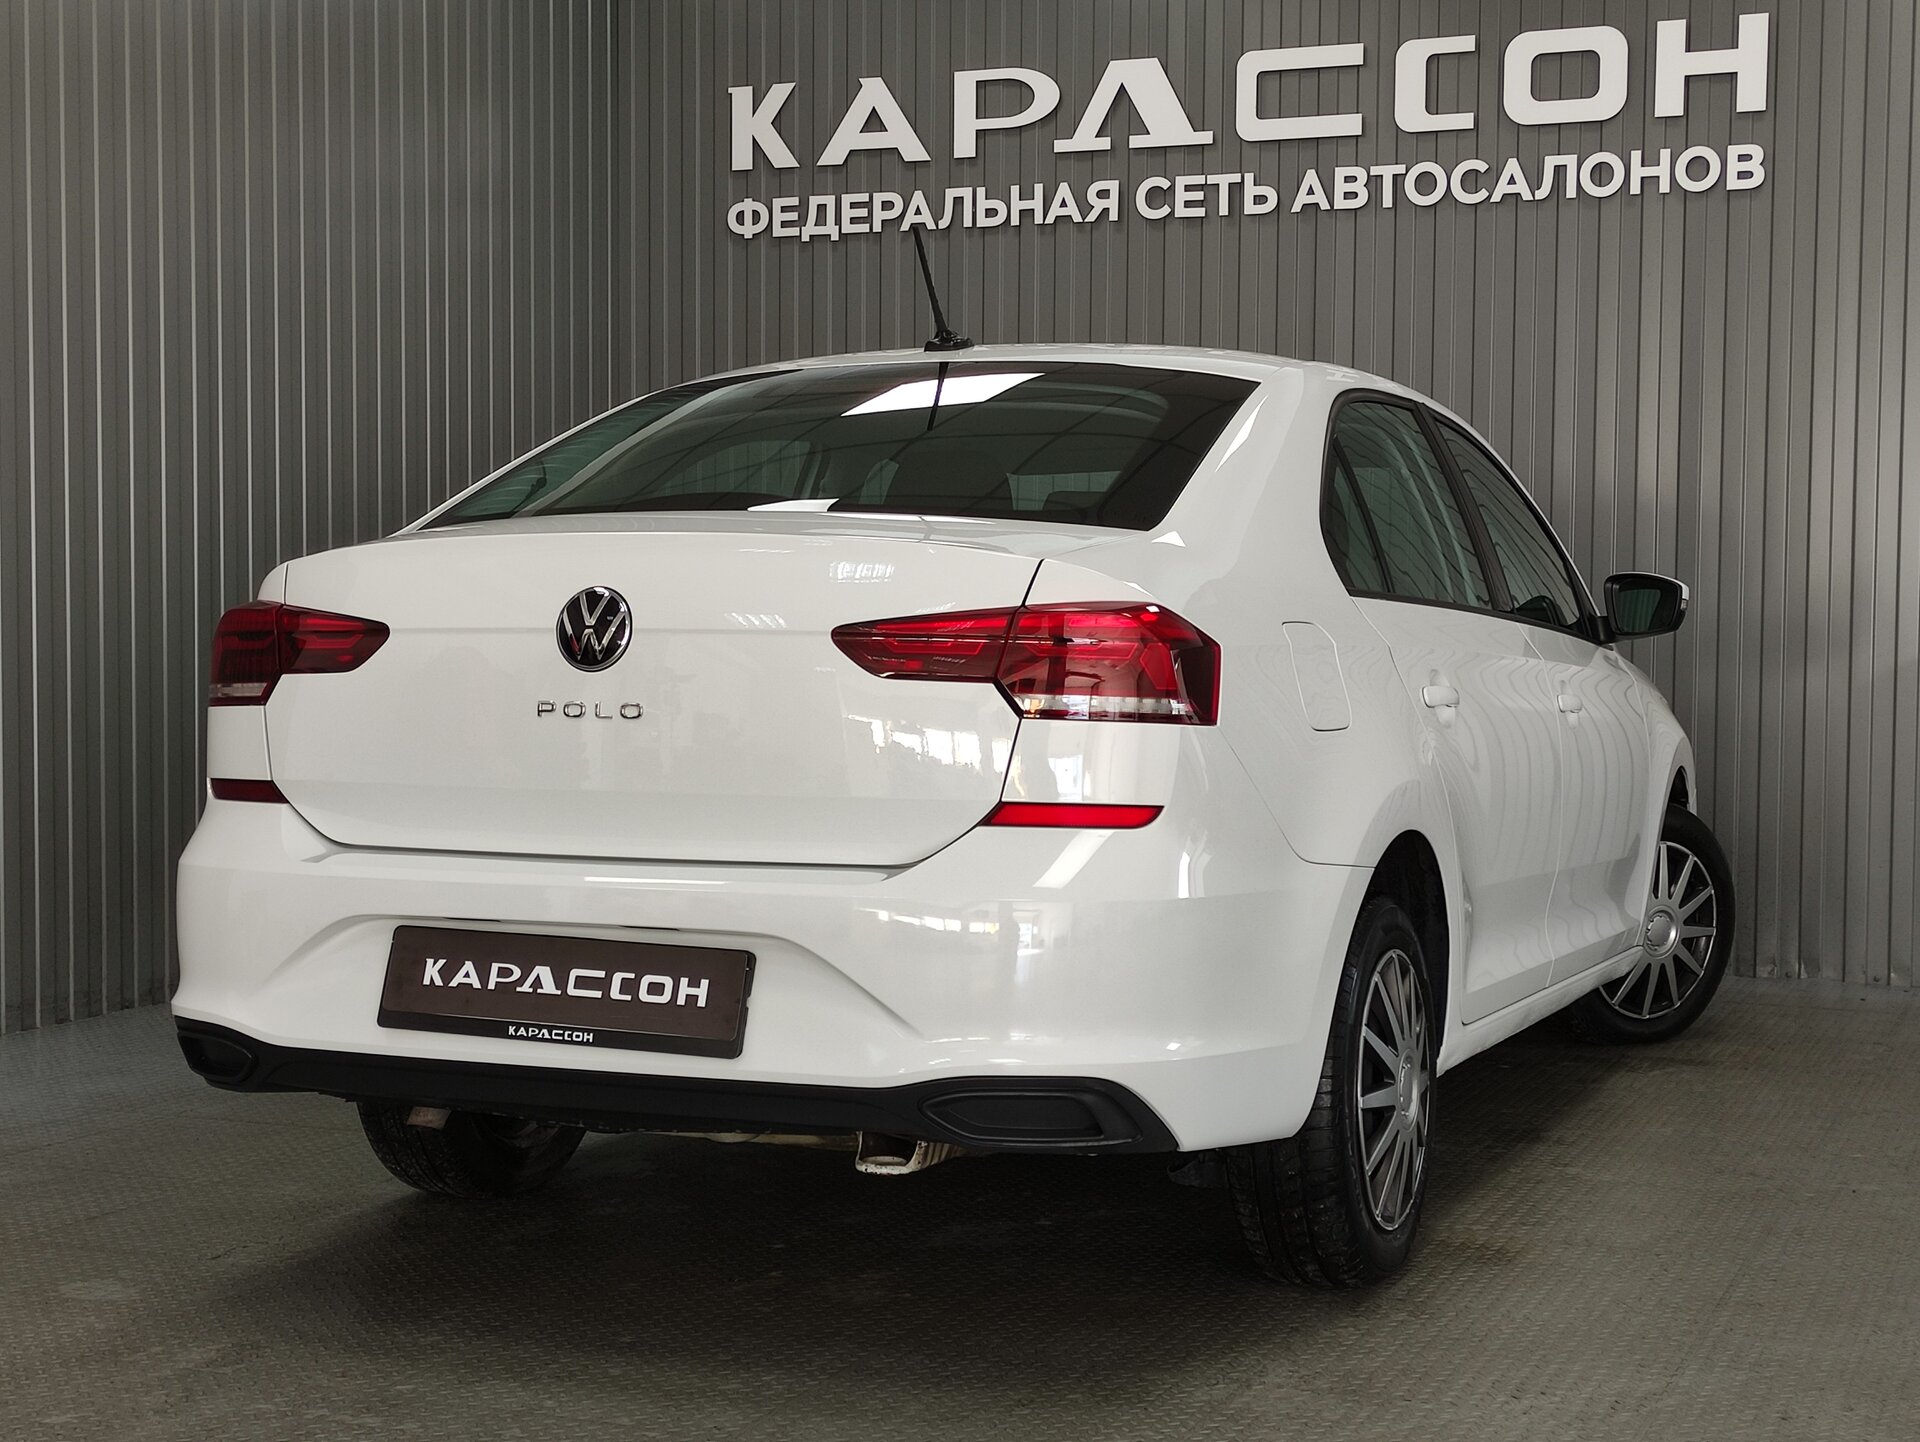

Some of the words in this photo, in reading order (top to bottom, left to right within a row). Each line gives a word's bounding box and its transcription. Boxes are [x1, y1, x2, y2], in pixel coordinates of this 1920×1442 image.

[727, 179, 1120, 242] ФЕДЕРАЛЬНАЯ
[1135, 172, 1279, 220] СЕТЬ
[1291, 143, 1766, 213] АВТОСАЛОНОВ
[537, 700, 644, 719] POLO
